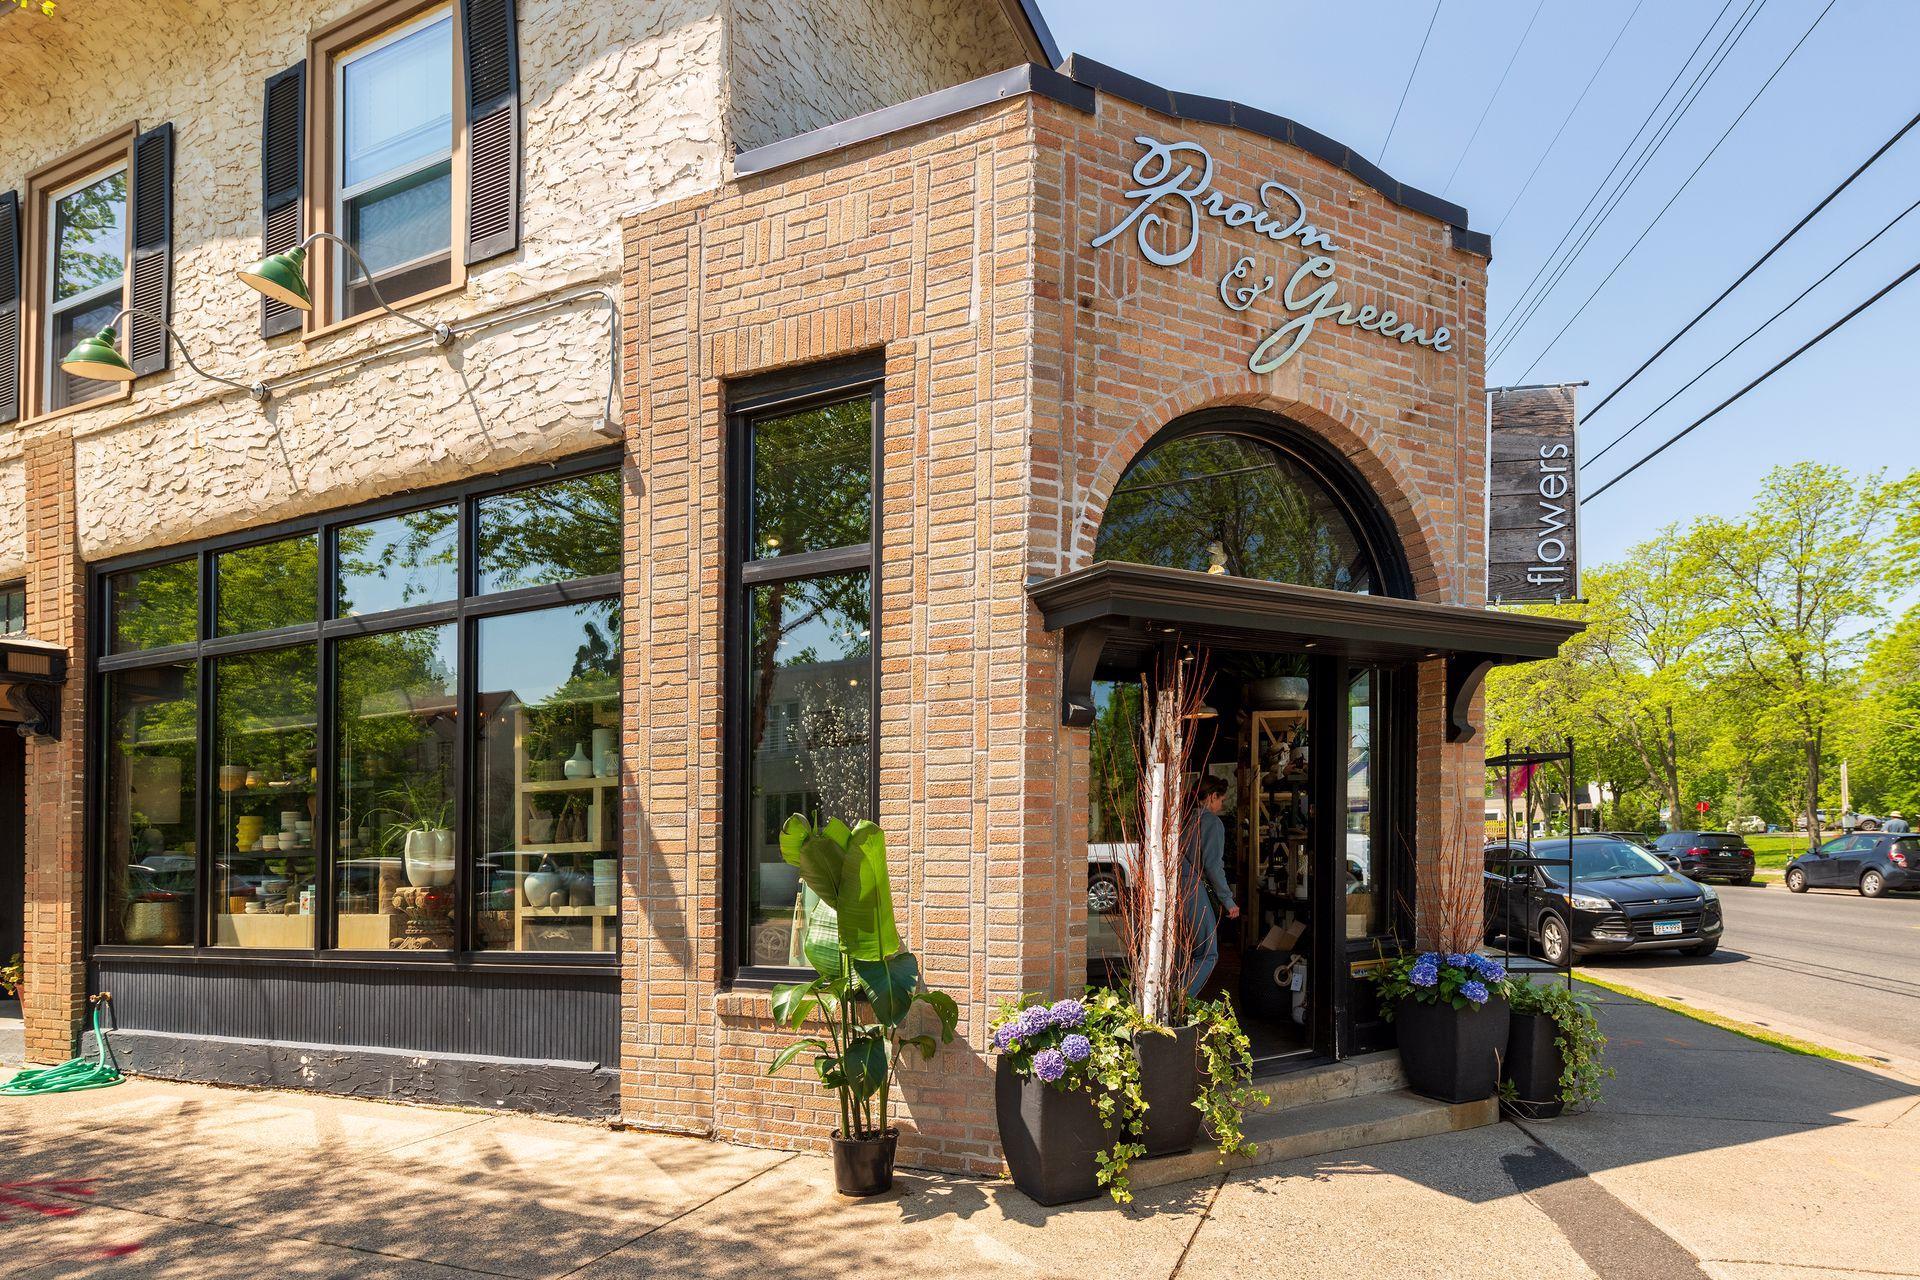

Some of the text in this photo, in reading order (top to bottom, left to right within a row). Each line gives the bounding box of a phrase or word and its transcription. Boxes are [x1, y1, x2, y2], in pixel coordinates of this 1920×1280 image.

[1092, 135, 1339, 266] Brown
[1220, 256, 1452, 374] & Greene
[1527, 443, 1568, 585] flowers
